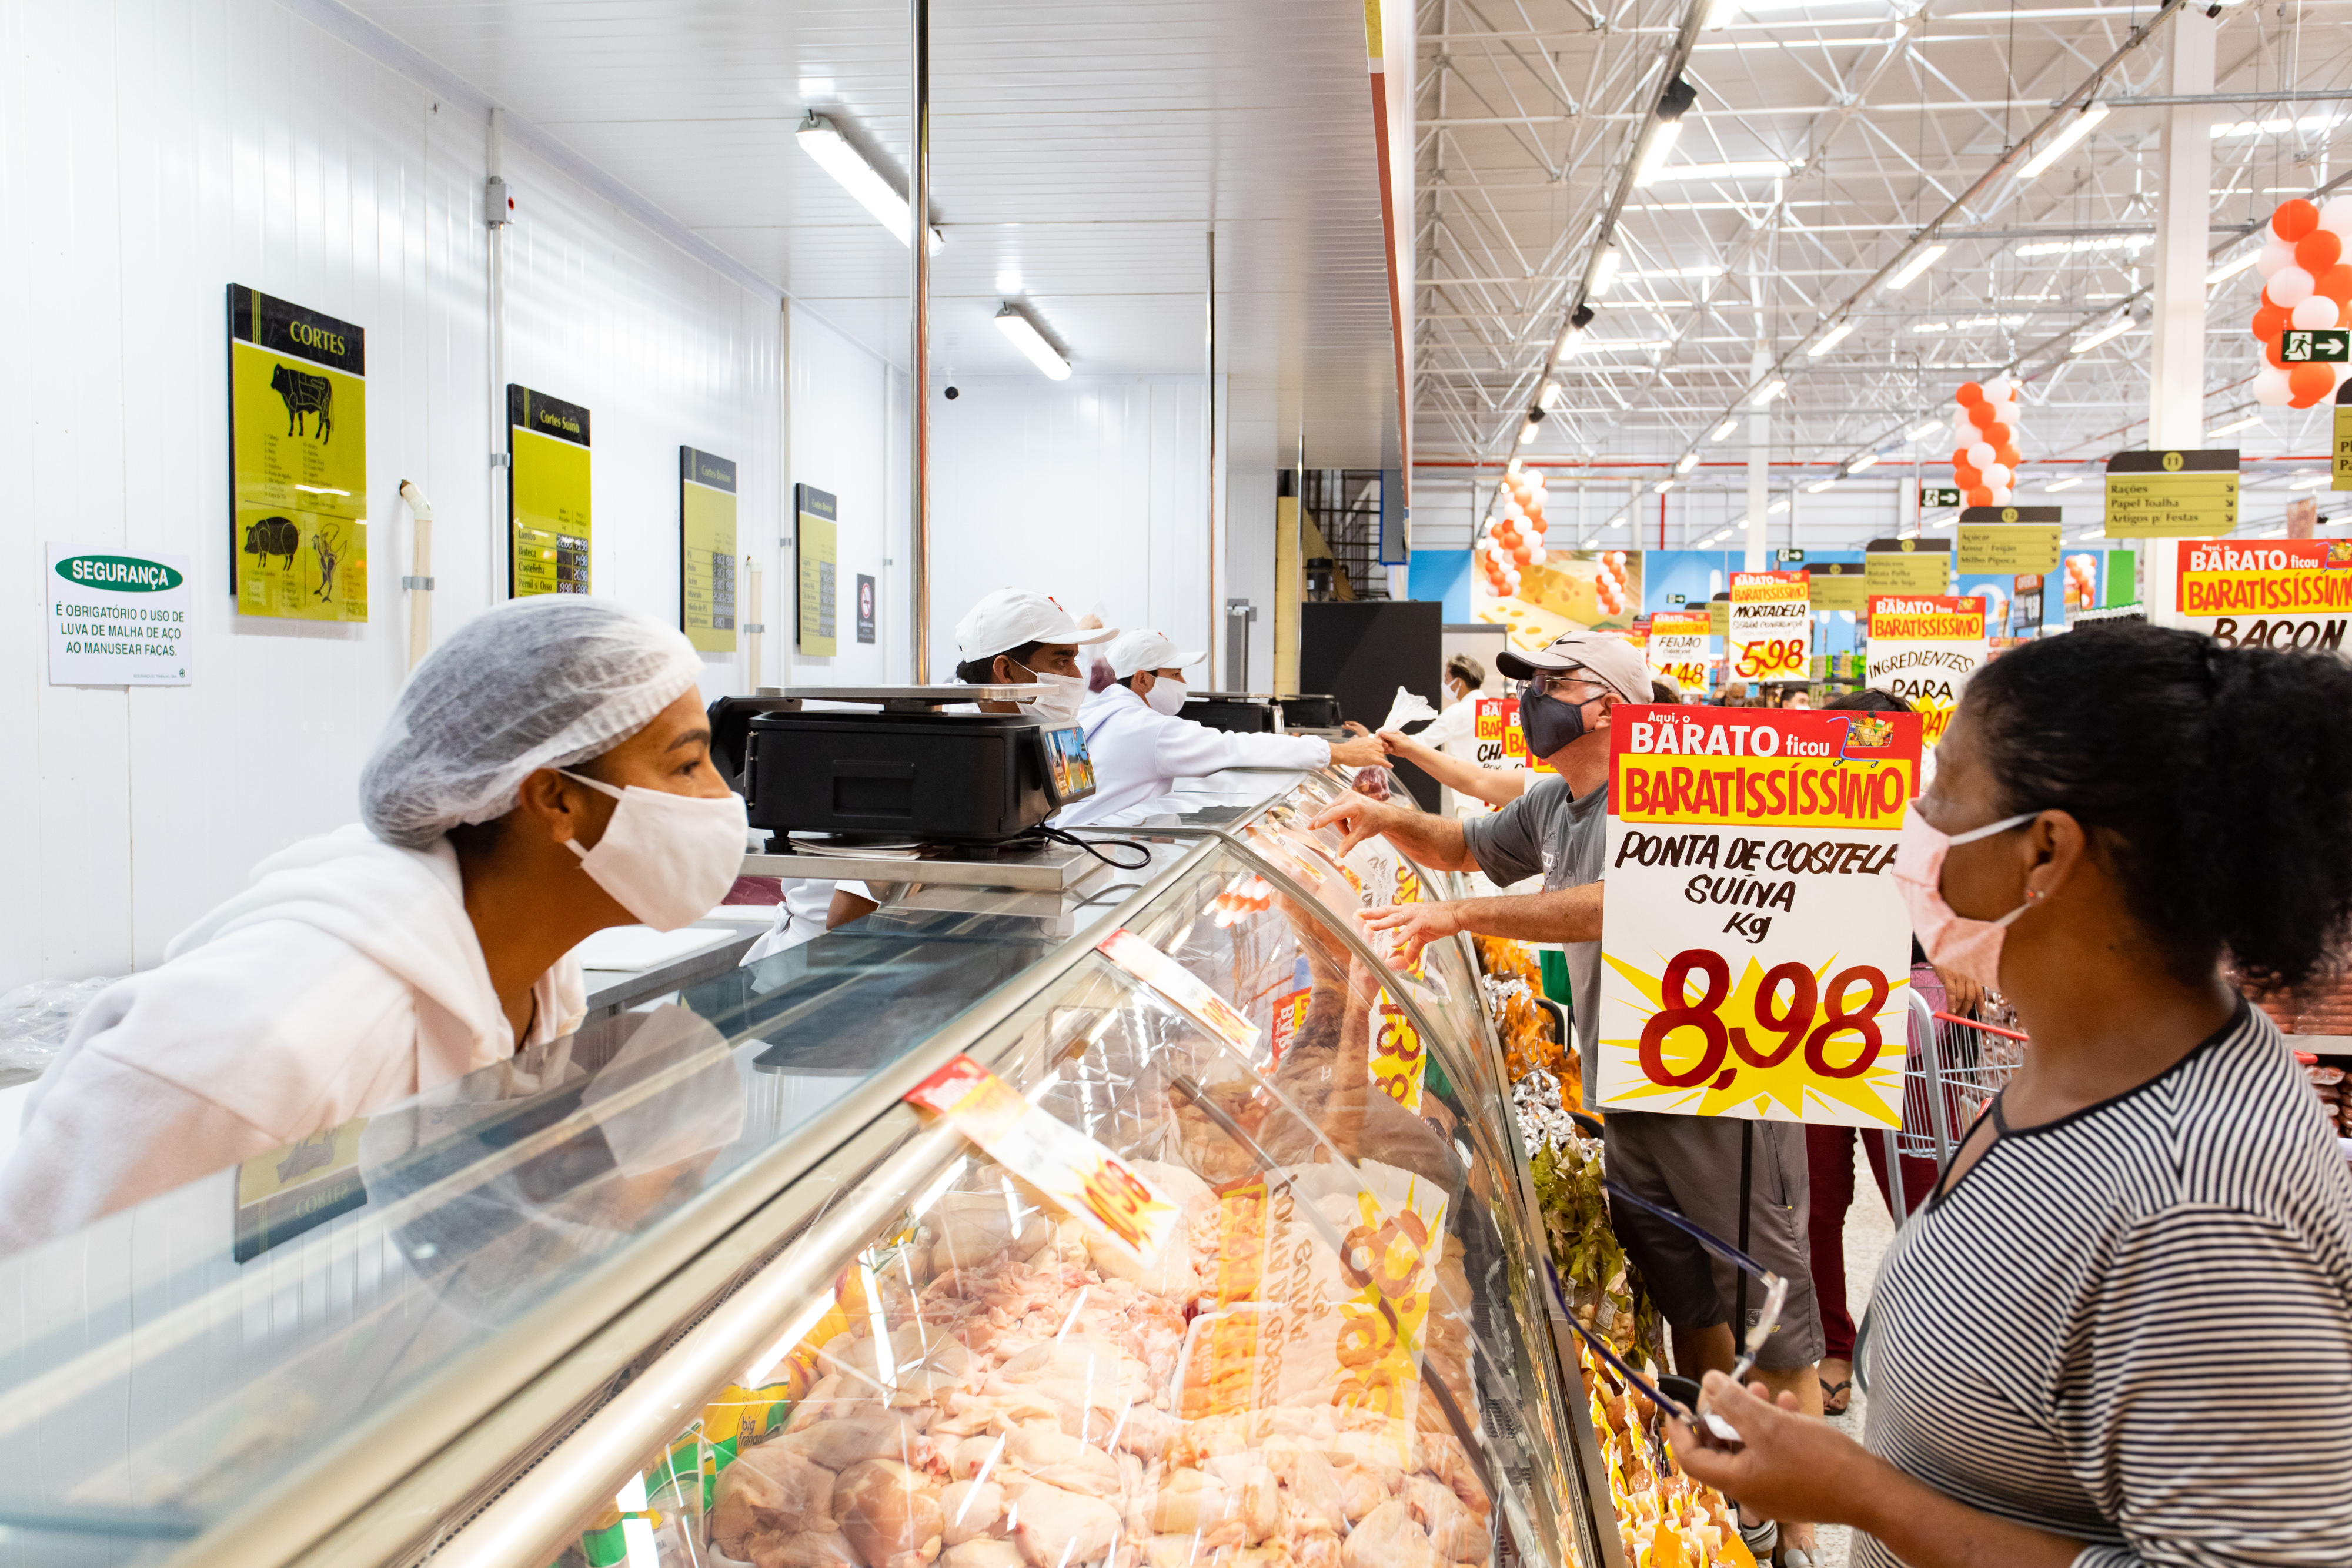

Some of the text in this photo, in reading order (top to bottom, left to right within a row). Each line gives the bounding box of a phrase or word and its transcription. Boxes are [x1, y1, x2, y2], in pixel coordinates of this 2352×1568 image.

[290, 321, 345, 356] CORTES
[540, 410, 580, 433] Cortes Suíno
[2167, 457, 2179, 466] 11
[2111, 485, 2148, 494] Rações
[2111, 499, 2179, 509] Papel Toalha
[2111, 514, 2148, 524] Artigos
[2166, 513, 2199, 522] Festas
[518, 529, 536, 541] Lombo
[1962, 533, 1990, 541] Açúcar
[519, 546, 536, 558] Bisteca
[1991, 544, 2016, 554] Feijão
[2201, 544, 2223, 552] Aqui,
[519, 562, 545, 574] Costelinha
[1987, 557, 2016, 566] Pipoca
[2190, 550, 2318, 572] BARATO ficou
[72, 560, 169, 590] SEGURANÇA
[1735, 576, 1775, 586] BARATO
[519, 578, 534, 589] Pernil
[540, 581, 552, 591] Osso
[56, 601, 184, 622] É OBRIGATÓRIO O USO DE
[1733, 604, 1805, 618] MORTADELA
[1876, 601, 1953, 614] BARATO ficou
[61, 623, 181, 642] LUVA DE MALHA DE AÇO
[2213, 618, 2347, 651] BACON
[66, 641, 178, 657] AO MANUSEAR FACAS.
[1735, 639, 1804, 677] 5,98
[1869, 651, 1975, 680] INGREDIENTES
[1893, 679, 1953, 701] PARA
[1648, 711, 1690, 725] Aqui, o
[1631, 722, 1830, 757] BARATO ficou
[1626, 762, 1905, 820] BARATISSÍSSIMO
[1615, 831, 1720, 870] PONTA
[1724, 837, 1766, 871] DE
[1722, 912, 1772, 944] Kg
[1638, 948, 1889, 1091] 8,98
[742, 1416, 756, 1435] big
[738, 1432, 763, 1447] frango
